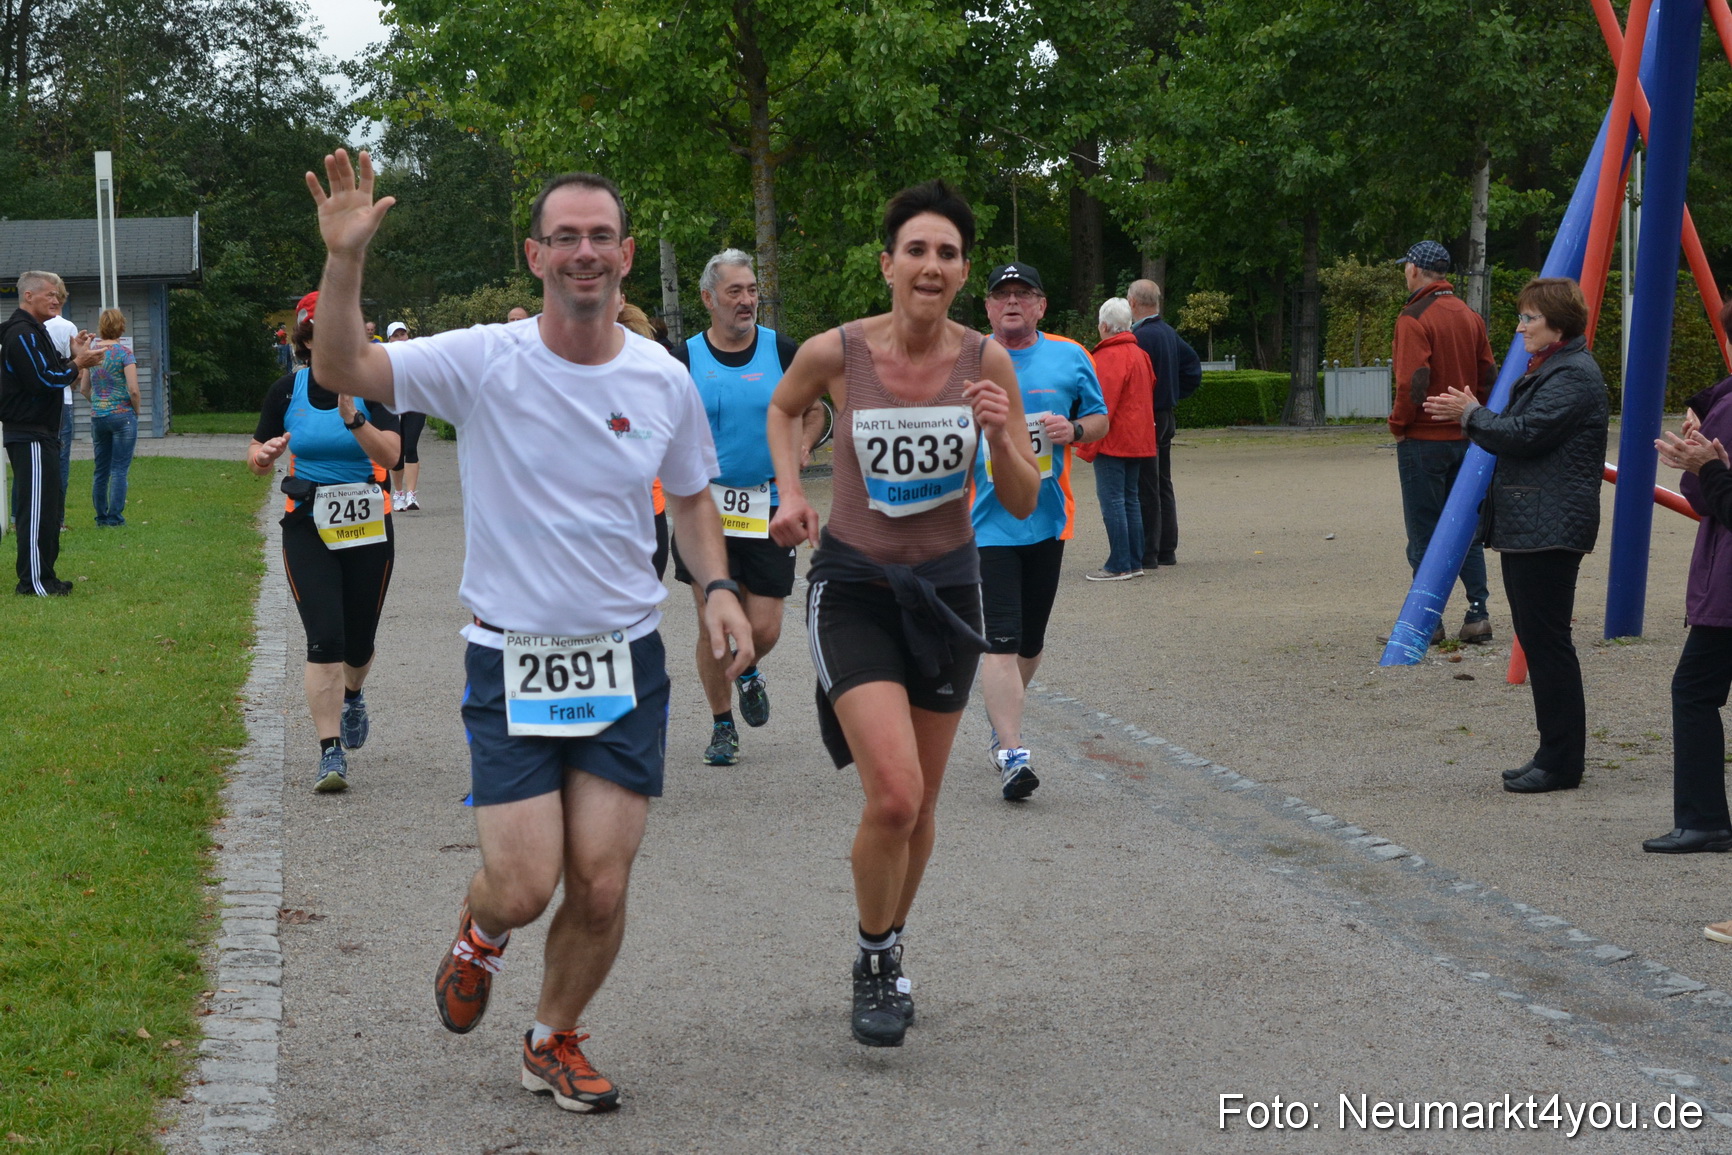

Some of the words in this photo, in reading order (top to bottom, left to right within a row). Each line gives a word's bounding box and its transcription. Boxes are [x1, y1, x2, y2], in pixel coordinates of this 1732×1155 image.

[855, 420, 896, 431] PARTL
[897, 418, 954, 430] Neumarkt
[866, 433, 964, 476] 2633
[338, 489, 370, 498] Neumarkt
[723, 489, 750, 514] 98
[887, 483, 942, 503] Claudia
[328, 498, 371, 525] 243
[336, 526, 366, 540] Margit
[506, 635, 548, 647] PARTL
[550, 635, 608, 648] Neumarkt
[518, 649, 617, 694] 2691
[548, 701, 596, 721] Frank
